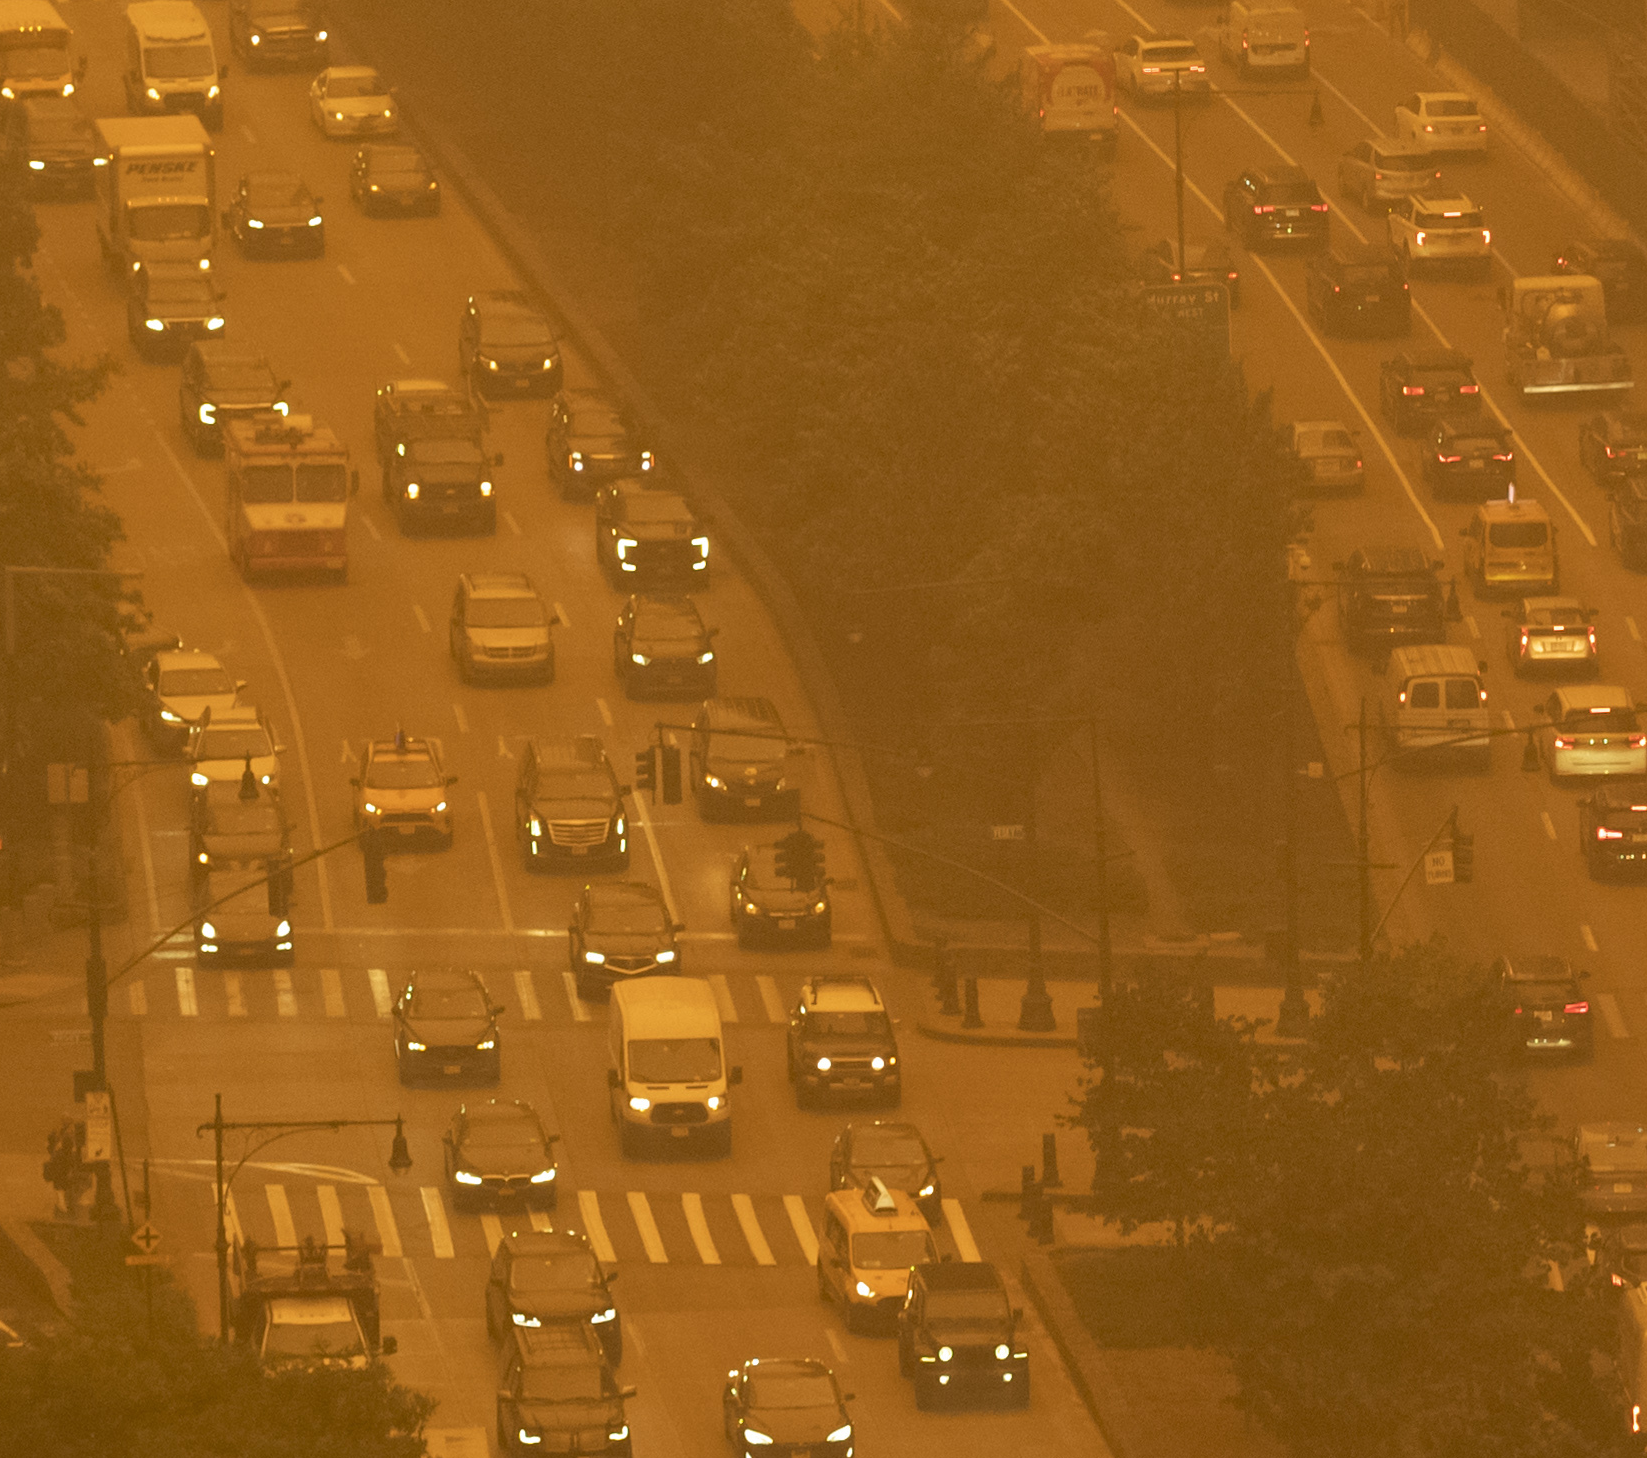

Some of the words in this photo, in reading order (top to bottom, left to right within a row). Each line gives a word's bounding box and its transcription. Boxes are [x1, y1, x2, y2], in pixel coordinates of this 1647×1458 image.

[126, 160, 198, 175] PENSKE
[1147, 294, 1196, 307] Murray
[1205, 290, 1219, 303] St
[1432, 856, 1445, 866] NO
